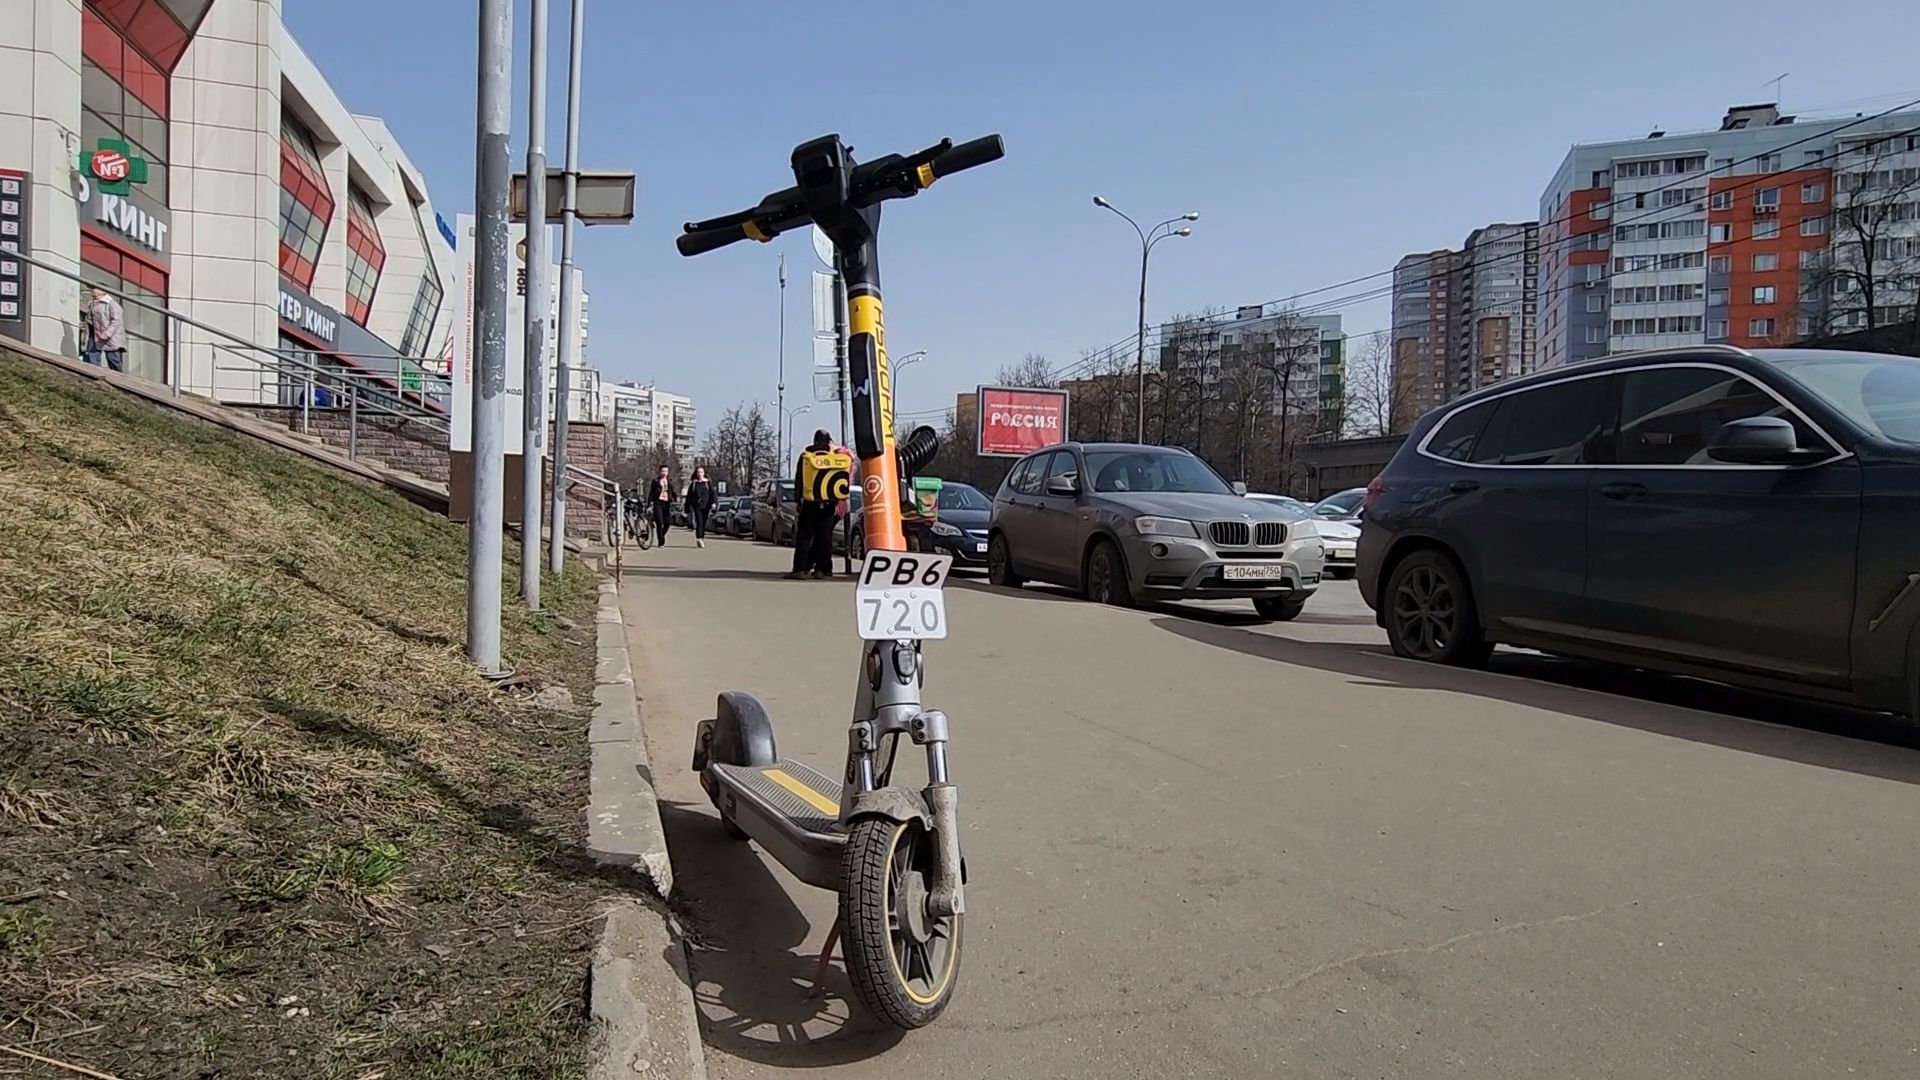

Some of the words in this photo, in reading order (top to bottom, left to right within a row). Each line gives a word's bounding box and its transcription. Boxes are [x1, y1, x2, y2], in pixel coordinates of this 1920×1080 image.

[102, 193, 168, 252] КИНГ
[280, 290, 302, 323] ГЕР
[304, 305, 336, 342] КИНГ
[990, 411, 1058, 430] РОССИЯ
[863, 598, 939, 632] 720
